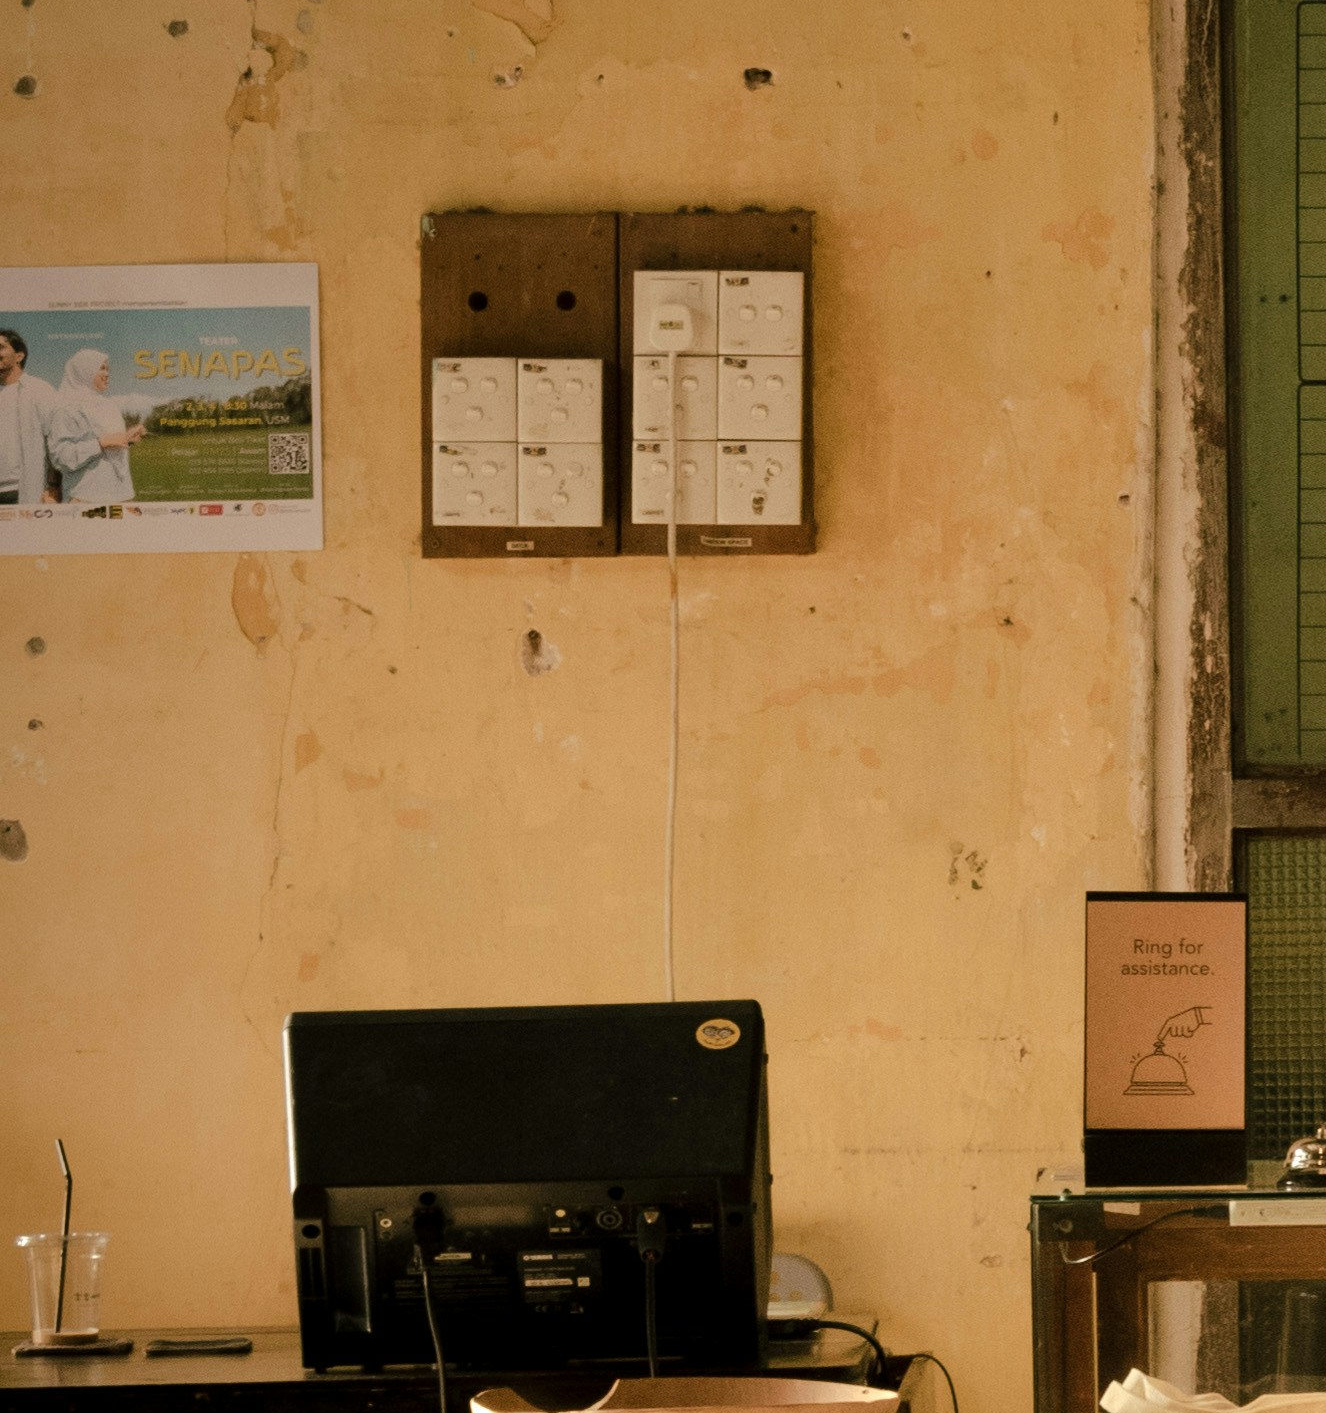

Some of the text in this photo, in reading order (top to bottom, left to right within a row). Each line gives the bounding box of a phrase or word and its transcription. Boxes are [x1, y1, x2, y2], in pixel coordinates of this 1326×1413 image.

[134, 347, 307, 380] SENAPAS
[160, 417, 217, 428] Panggung
[1132, 938, 1204, 959] Ring for
[1120, 959, 1215, 977] assistance.
